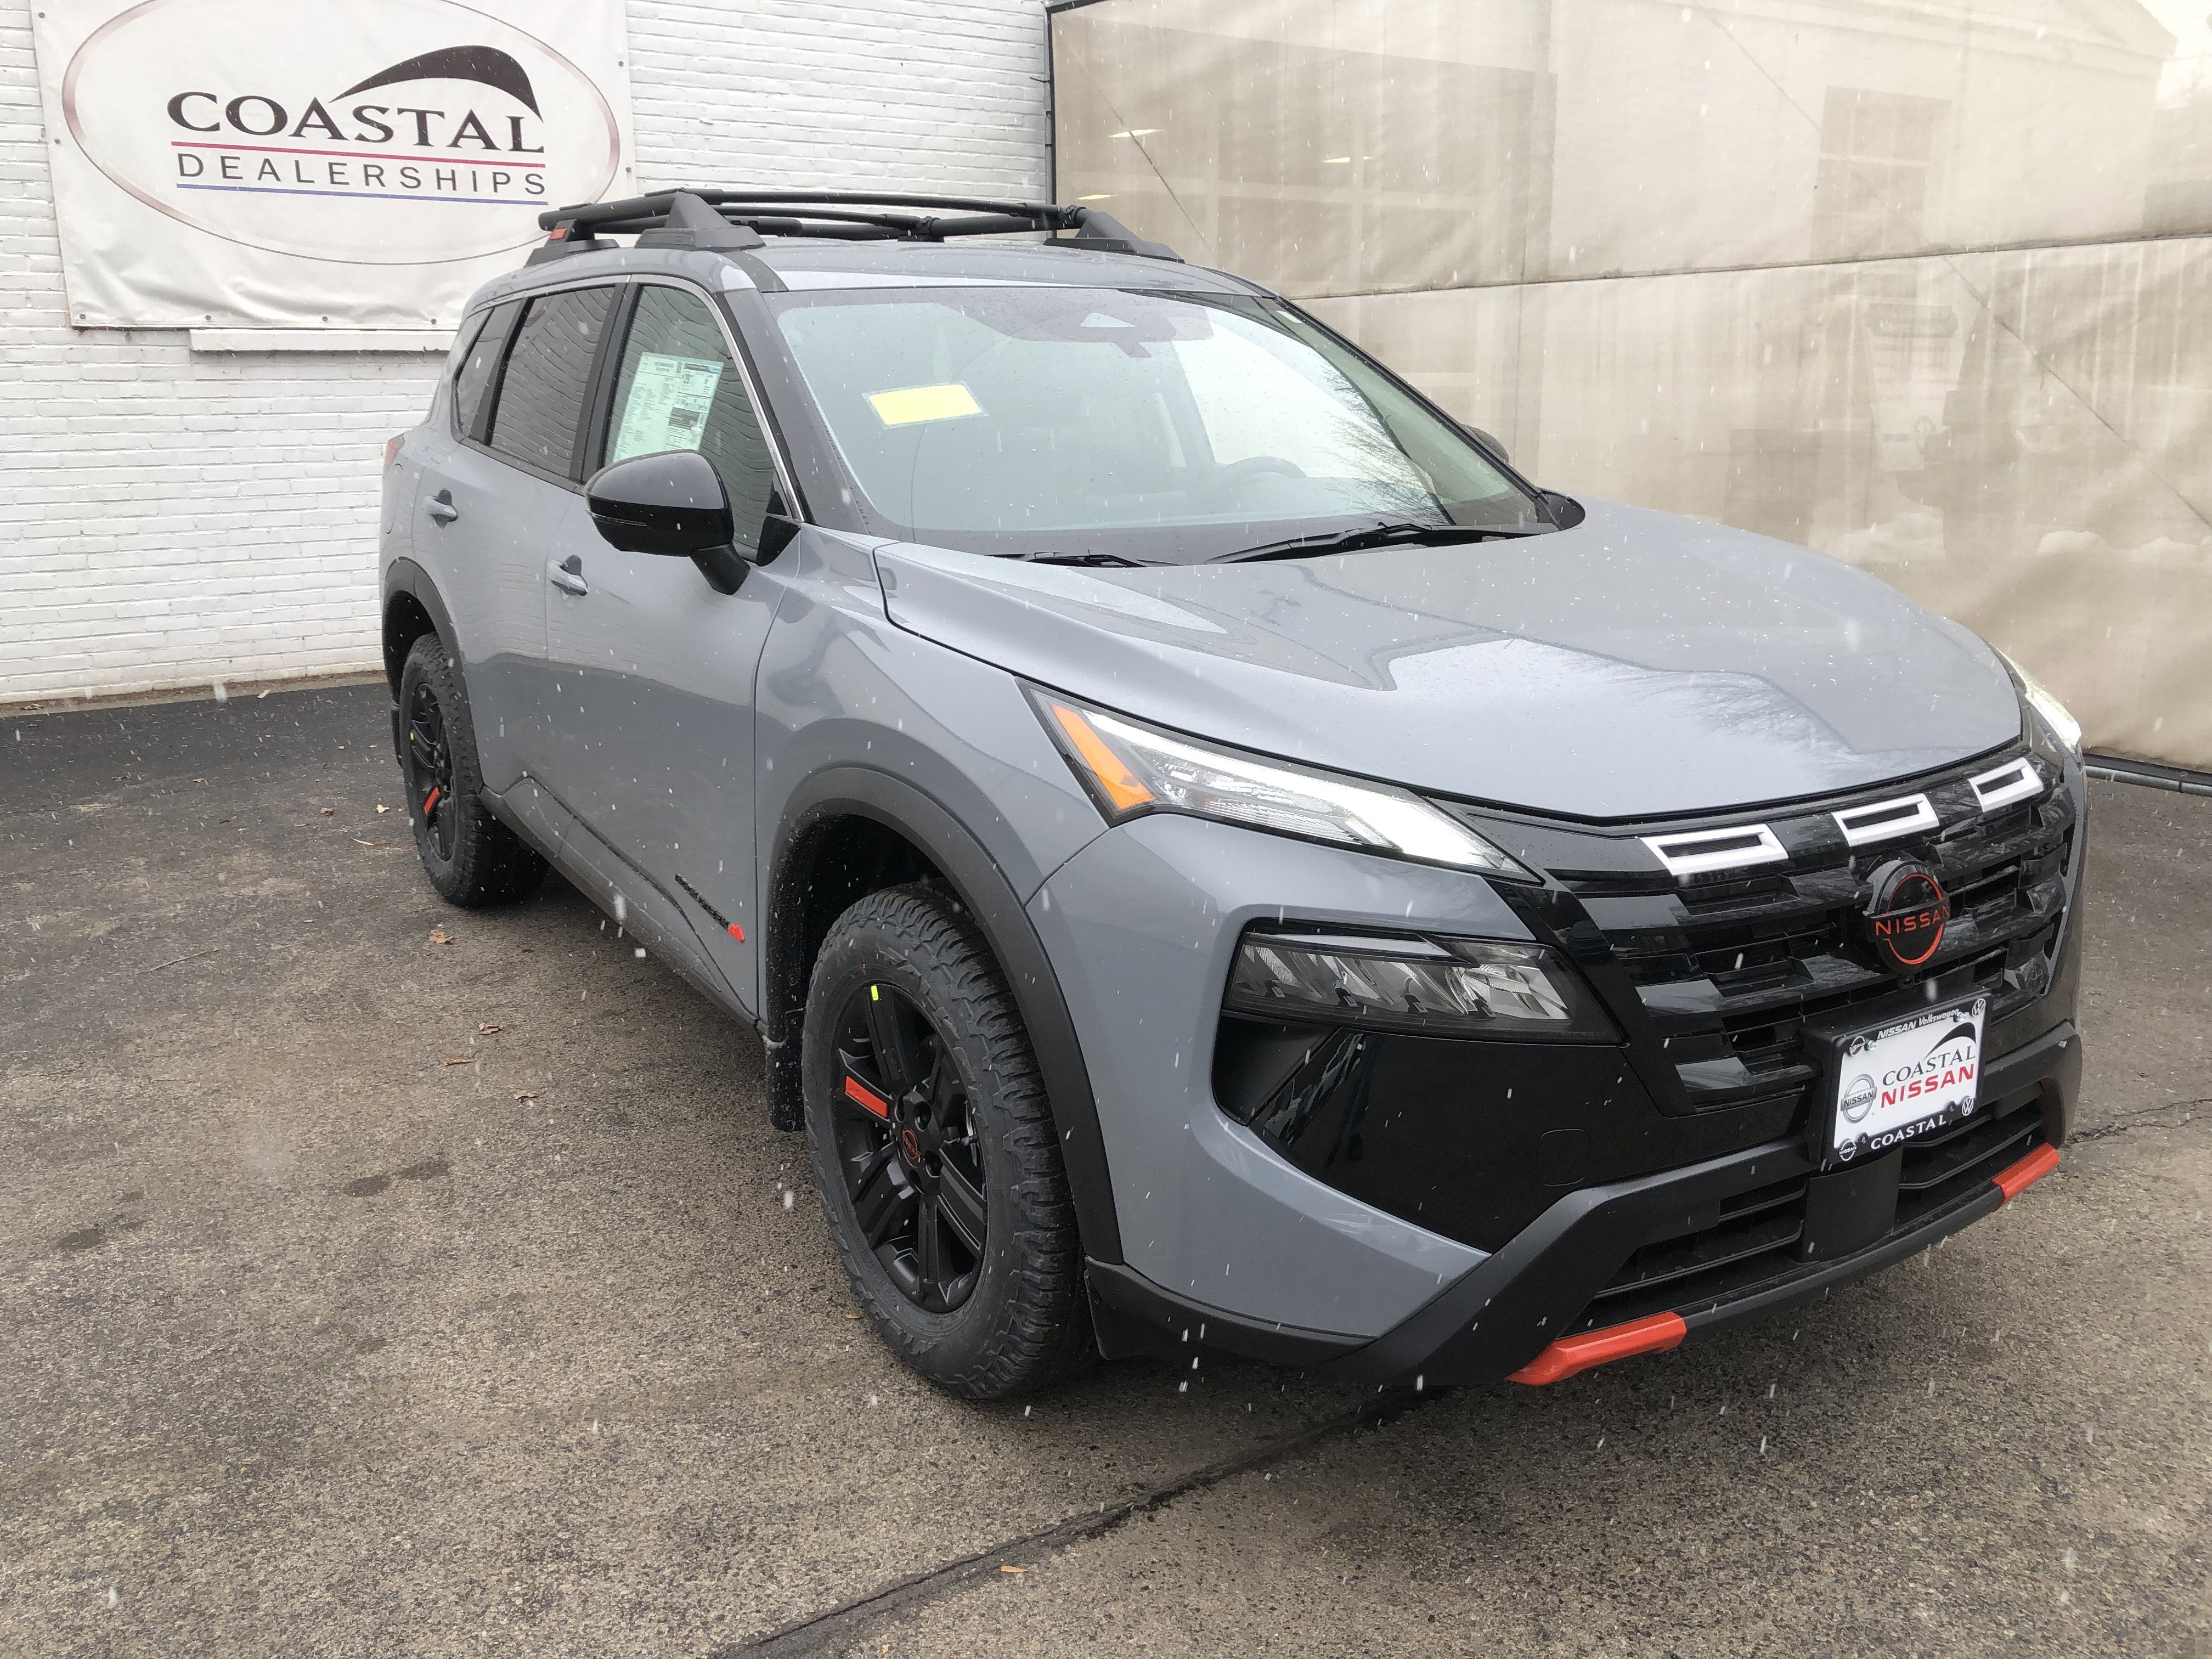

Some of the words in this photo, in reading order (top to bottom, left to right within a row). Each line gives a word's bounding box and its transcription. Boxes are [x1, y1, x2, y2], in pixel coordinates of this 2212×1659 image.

[167, 91, 545, 154] COASTAL
[177, 153, 546, 195] DEALERSHIPS
[1875, 905, 1950, 935] NISSAN
[1877, 1020, 1917, 1040] NISSAN
[1918, 1008, 1959, 1026] Volkswagen
[1882, 1045, 1976, 1086] COASTAL
[1843, 1090, 1874, 1107] NISSAN
[1881, 1063, 1974, 1108] NISSAN
[1871, 1114, 1946, 1150] COASTAL
